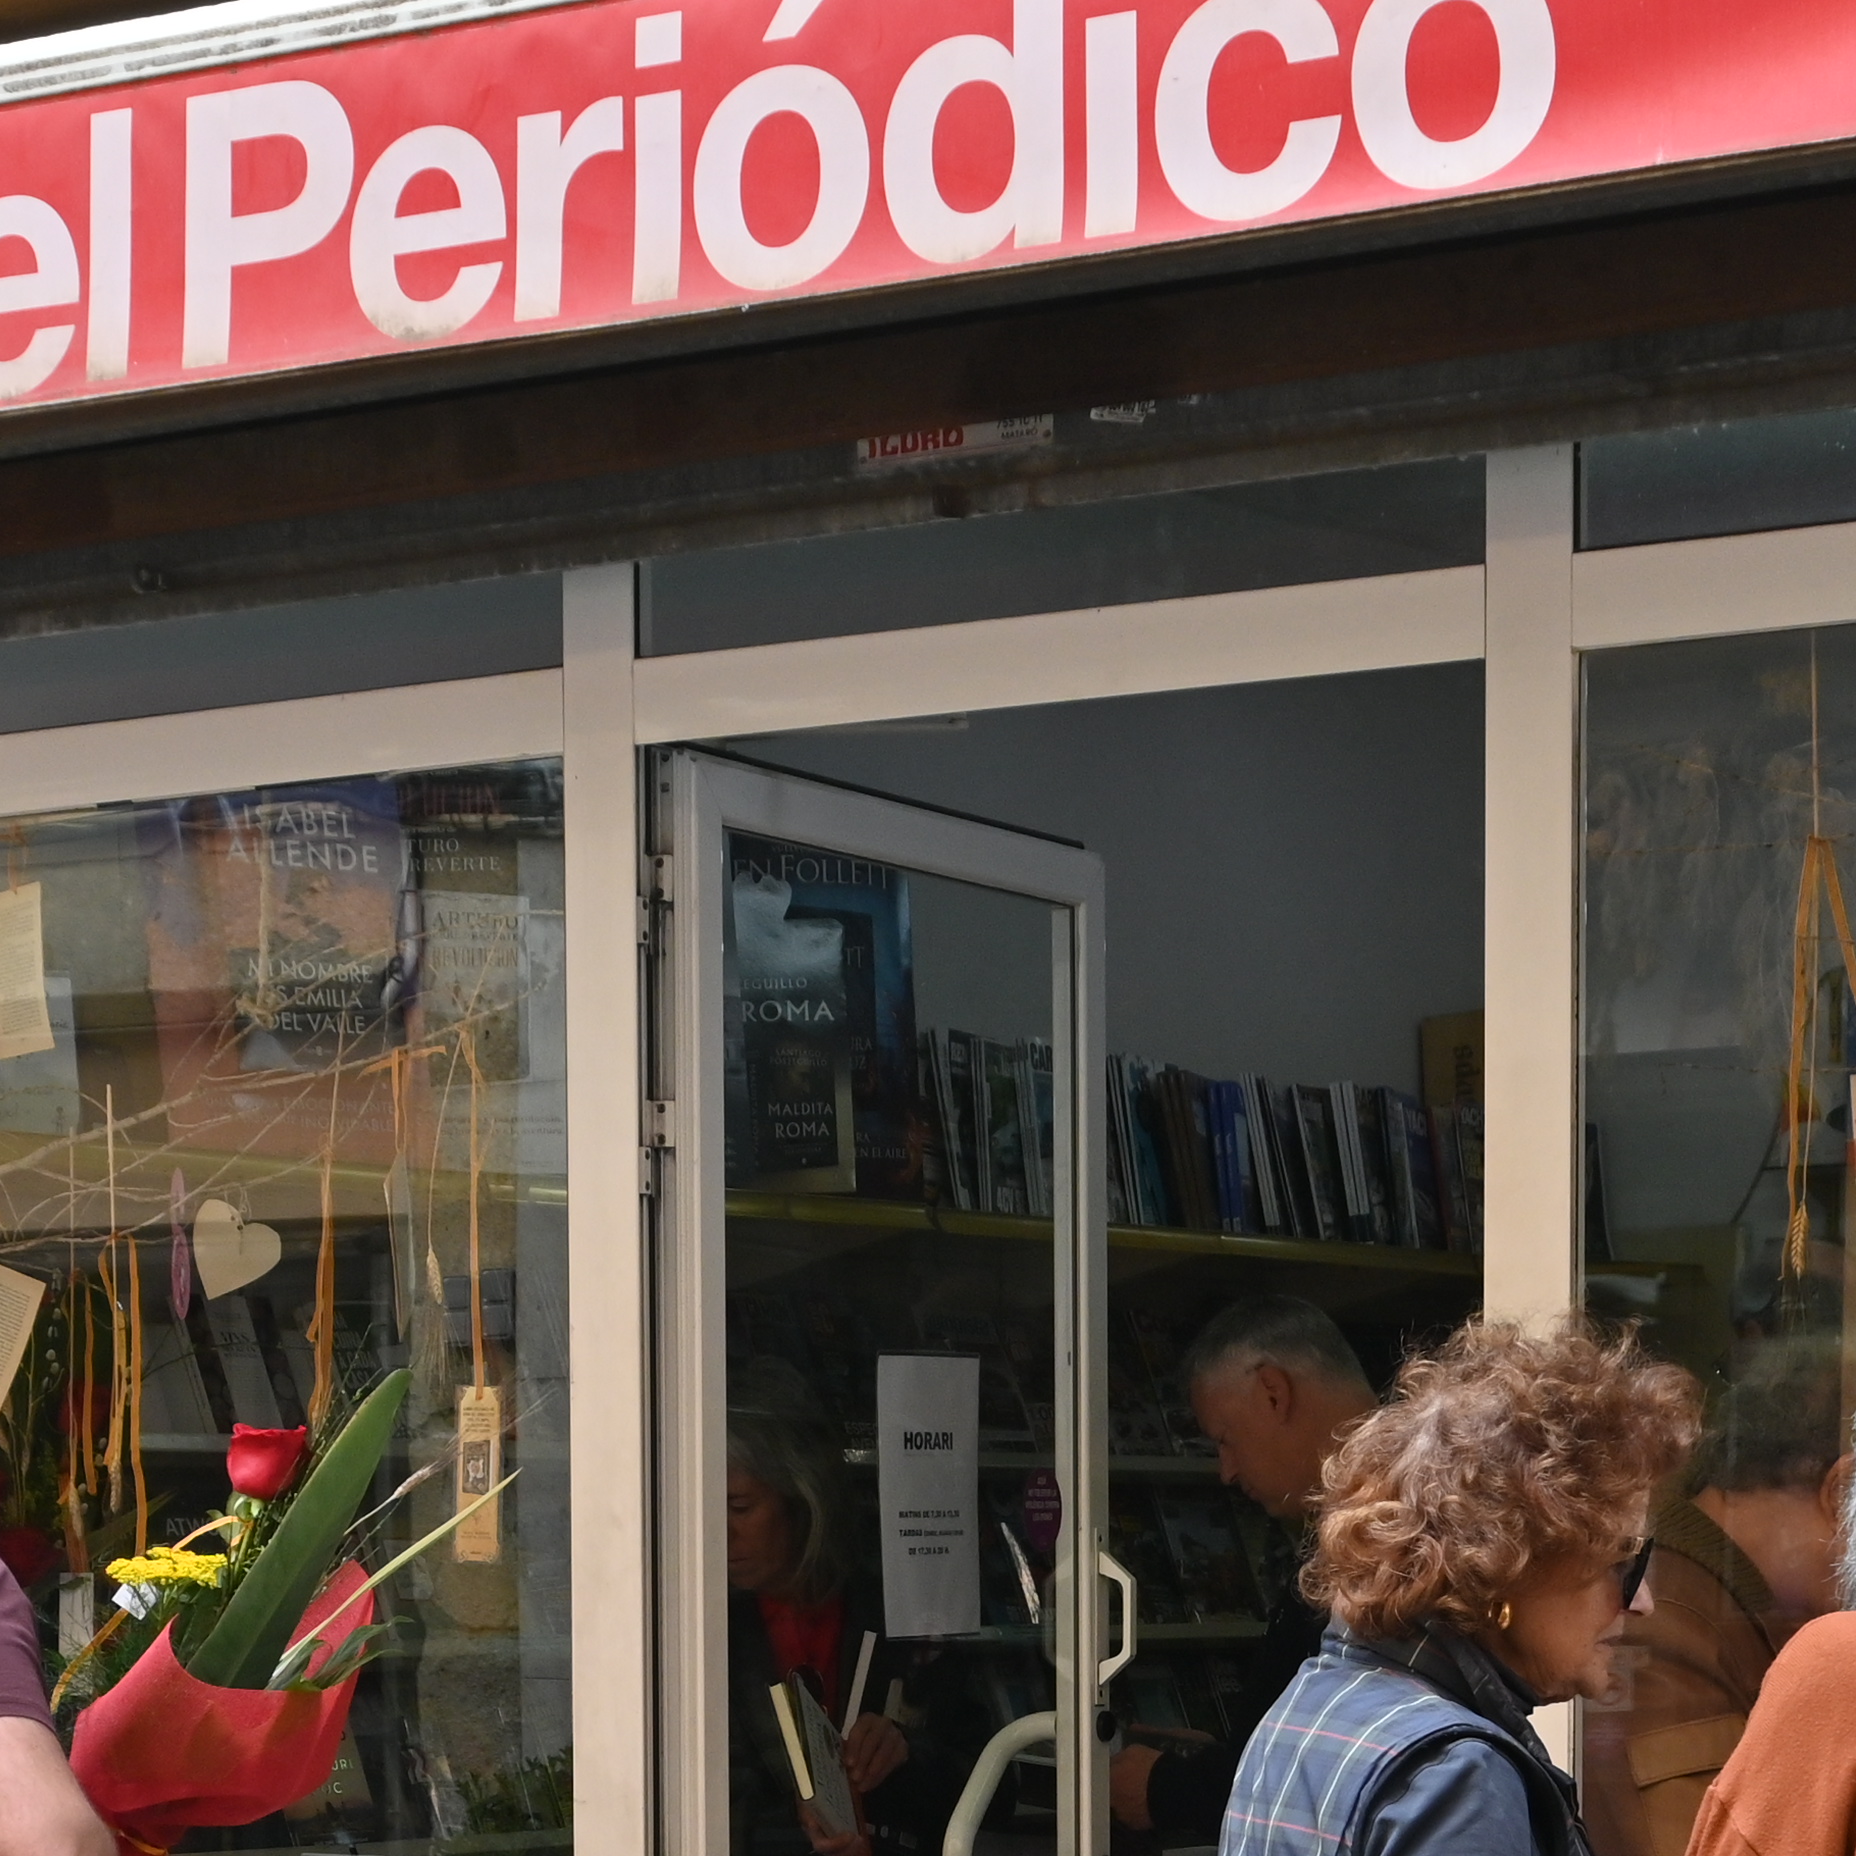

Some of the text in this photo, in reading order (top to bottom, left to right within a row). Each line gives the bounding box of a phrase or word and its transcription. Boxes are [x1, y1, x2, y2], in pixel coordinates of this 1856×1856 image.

[179, 0, 1557, 370] Periódico
[244, 801, 356, 839] ISABEL
[226, 836, 379, 874] ALLENDE
[780, 853, 888, 890] FOLLETT
[279, 959, 374, 984] NOMBRE
[293, 984, 364, 1009] EMILIA
[269, 1010, 367, 1035] DEL VALLE
[742, 1000, 835, 1022] ROMA
[768, 1102, 834, 1117] MALDITA
[775, 1121, 831, 1139] ROMA
[904, 1431, 953, 1450] HORARI
